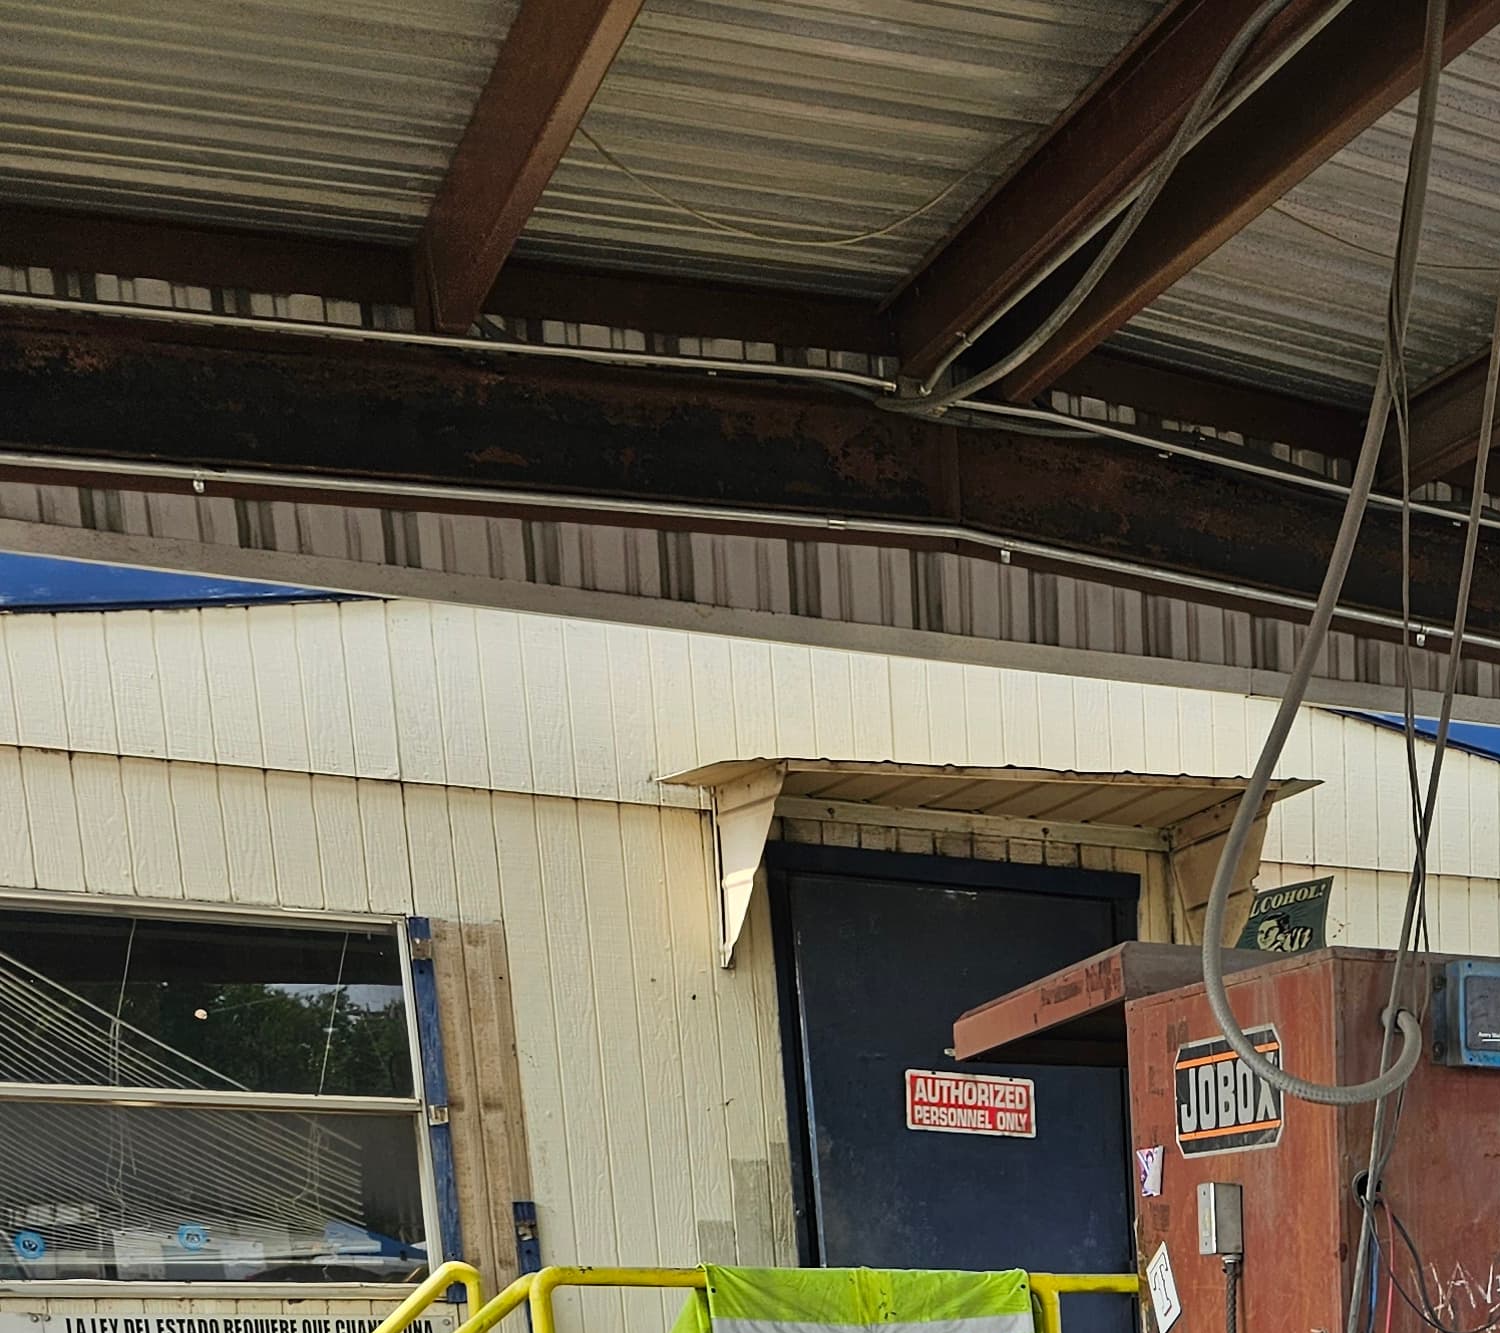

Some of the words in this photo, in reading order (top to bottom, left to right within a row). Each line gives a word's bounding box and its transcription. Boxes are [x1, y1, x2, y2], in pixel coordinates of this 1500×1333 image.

[914, 1077, 1027, 1110] AUTHORIZED
[1181, 1052, 1277, 1133] JOBOX
[914, 1106, 993, 1130] PERSONNEL
[996, 1111, 1028, 1132] ONLY
